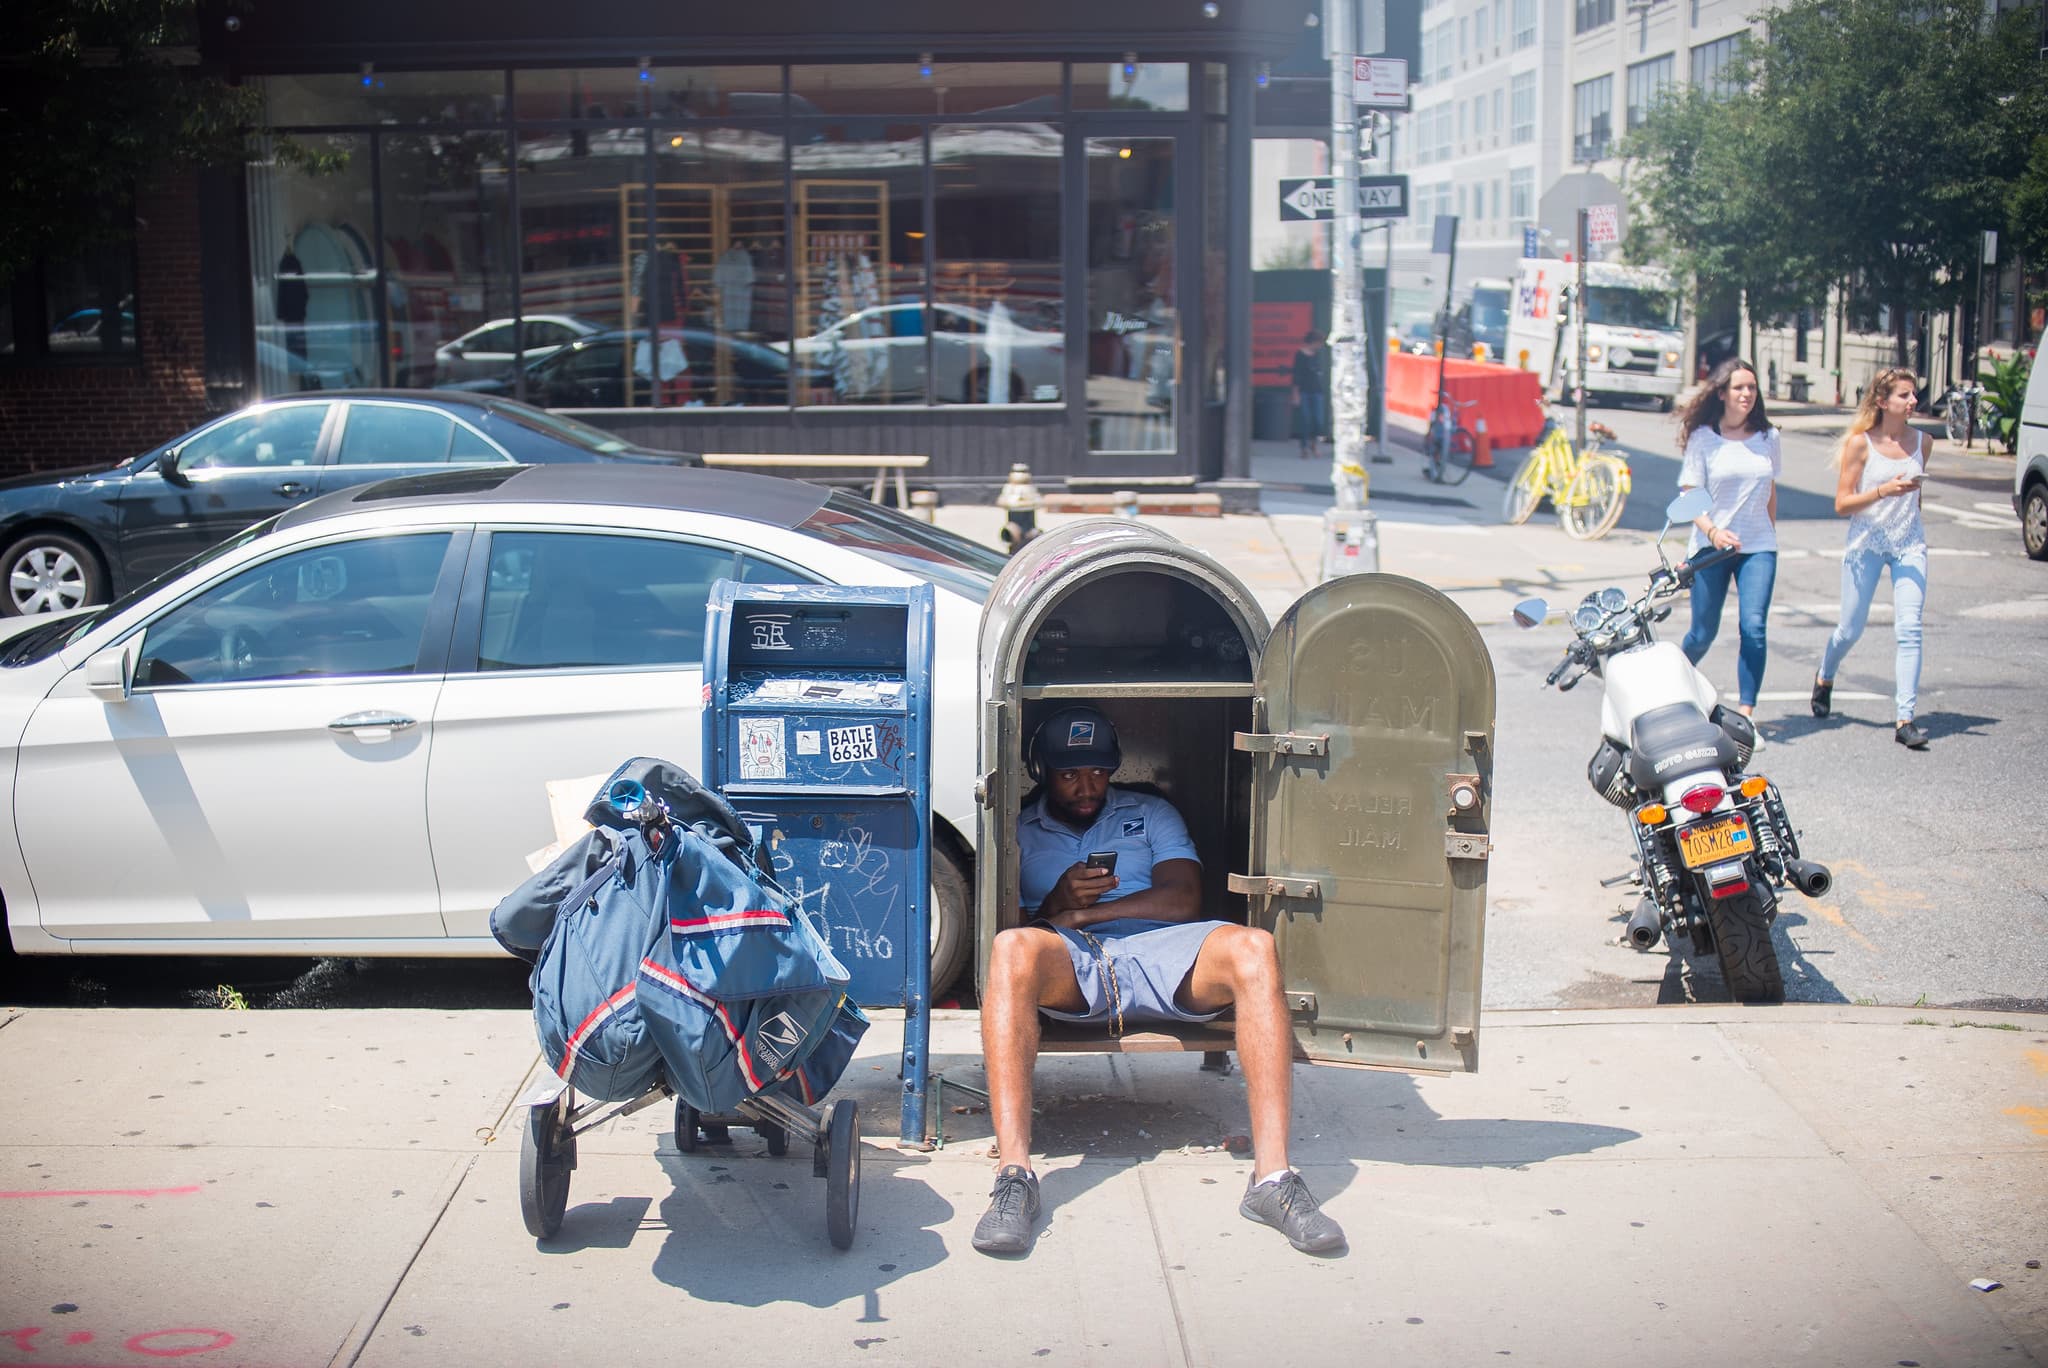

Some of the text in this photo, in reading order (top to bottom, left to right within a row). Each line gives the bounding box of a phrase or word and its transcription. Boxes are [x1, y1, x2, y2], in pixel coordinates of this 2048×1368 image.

[1298, 191, 1336, 208] ONE
[830, 727, 873, 746] BATLE
[833, 743, 874, 761] 663K
[1686, 829, 1734, 857] 70SM28
